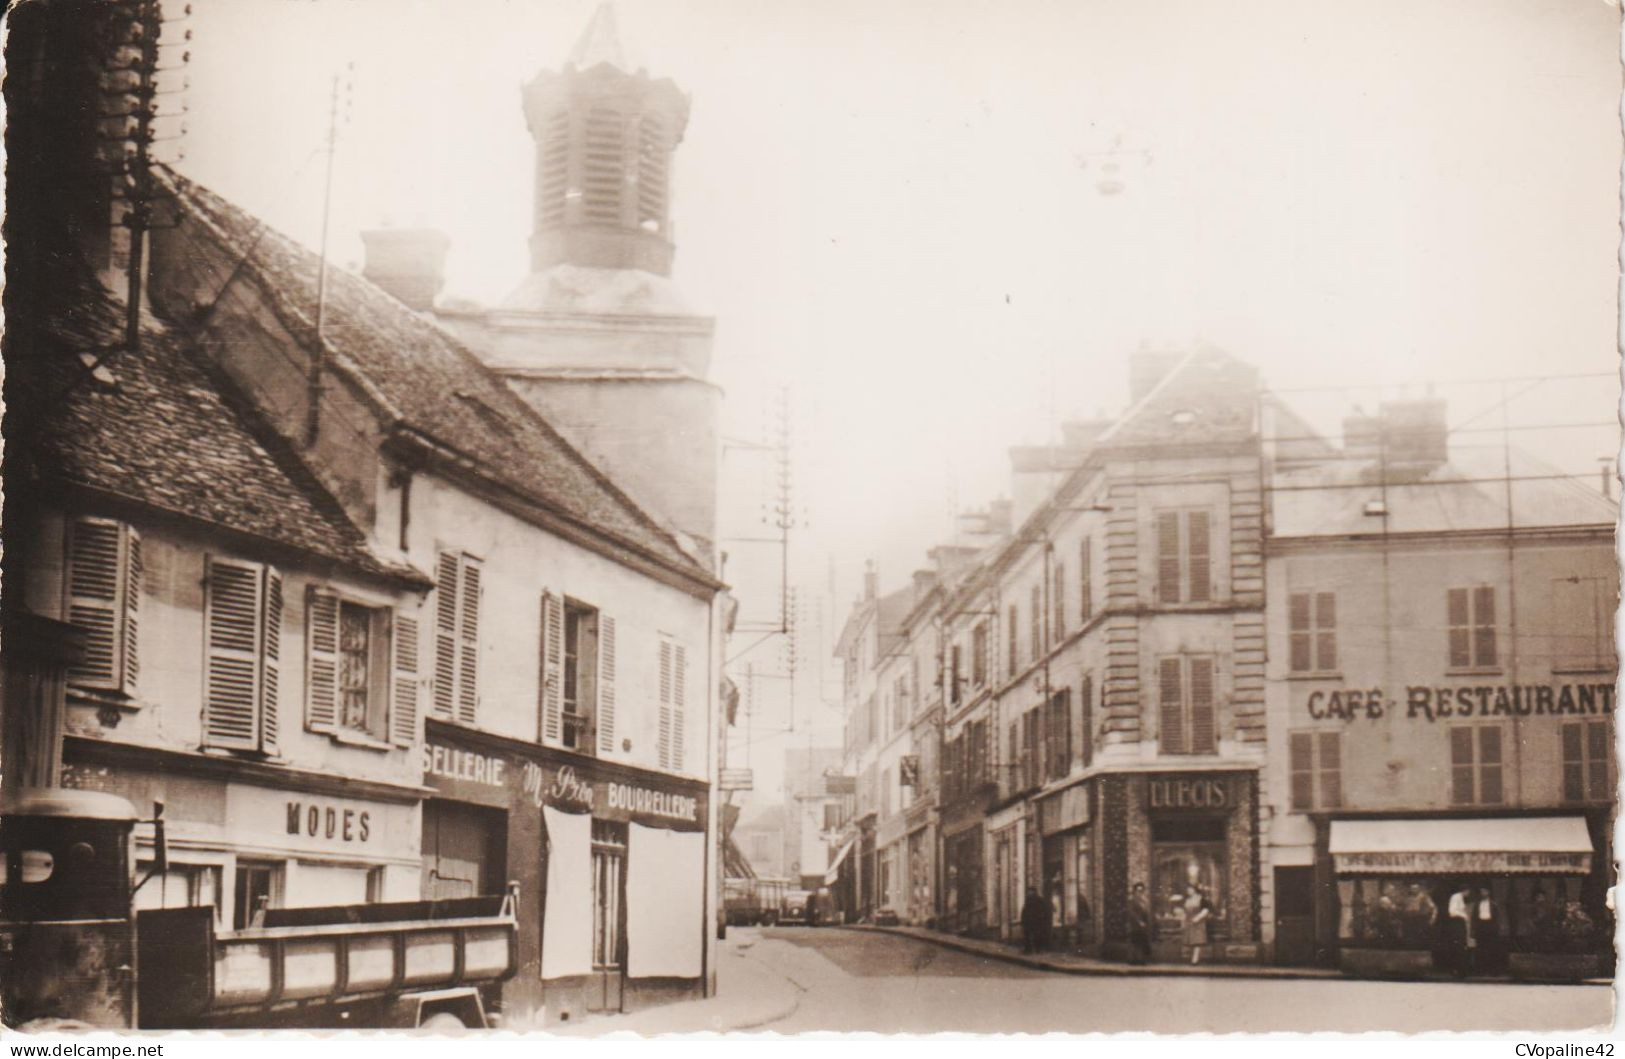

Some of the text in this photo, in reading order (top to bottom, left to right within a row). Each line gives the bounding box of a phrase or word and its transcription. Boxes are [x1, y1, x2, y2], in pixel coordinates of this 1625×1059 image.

[1407, 683, 1615, 722] RESTAURANT
[422, 743, 505, 787] SELLERIE
[608, 782, 697, 822] BOURRELLERIE
[287, 802, 371, 842] MODES
